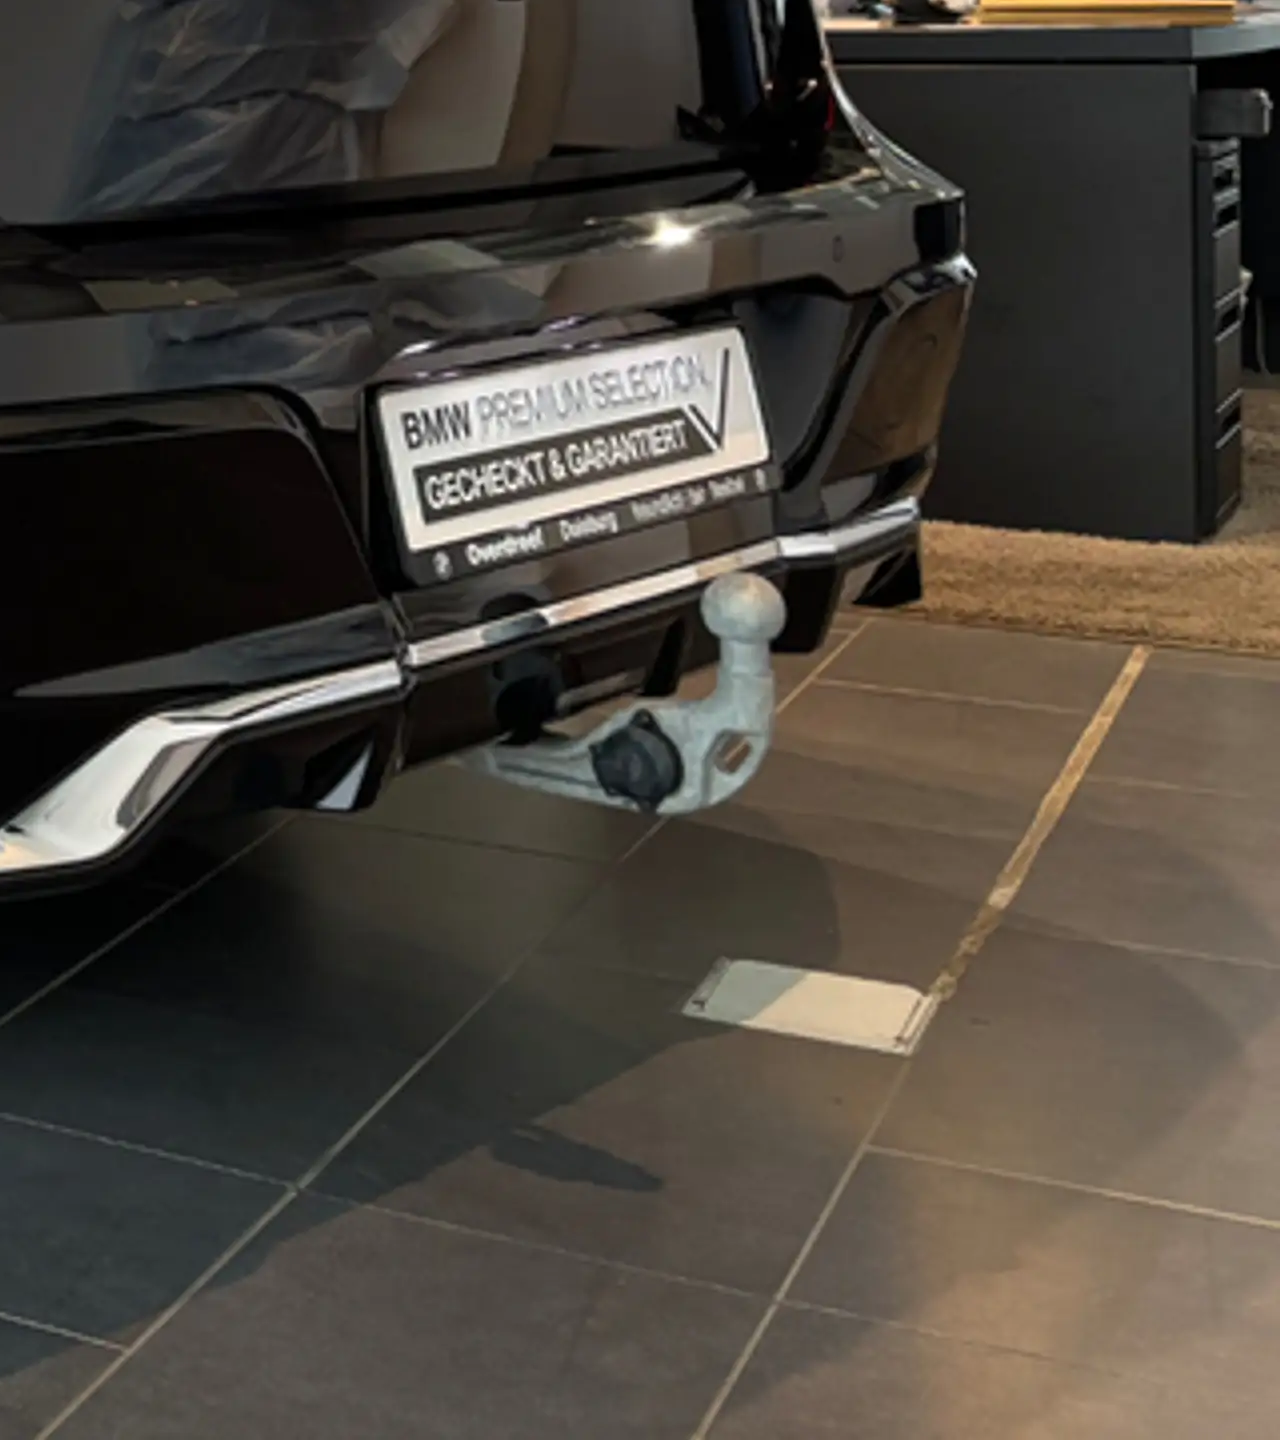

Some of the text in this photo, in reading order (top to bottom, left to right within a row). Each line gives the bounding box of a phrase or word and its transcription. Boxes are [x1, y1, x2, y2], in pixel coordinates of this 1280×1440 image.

[401, 353, 710, 450] BMW PREMIUM SELECTION
[424, 419, 688, 510] GECHECKT & GARANTIERT
